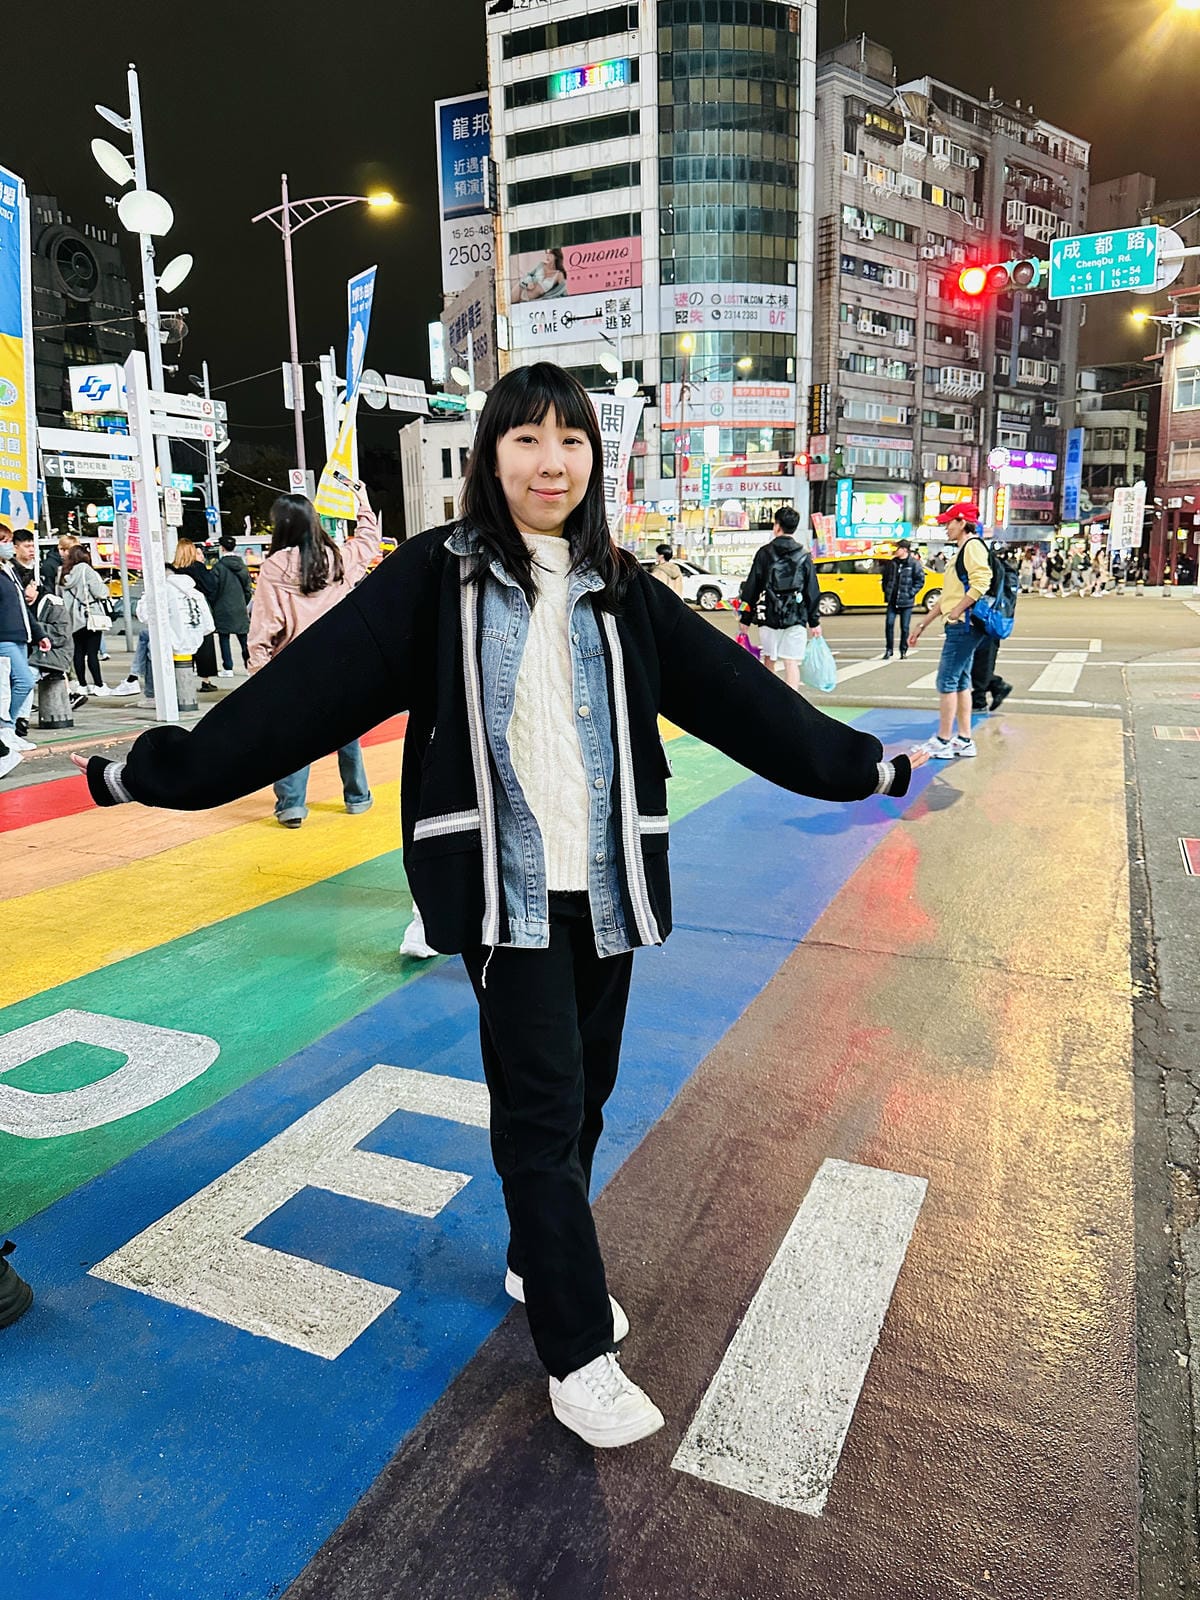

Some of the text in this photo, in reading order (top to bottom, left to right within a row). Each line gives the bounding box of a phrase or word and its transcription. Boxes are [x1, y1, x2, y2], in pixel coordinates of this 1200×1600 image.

[452, 113, 490, 141] 龍邦
[454, 178, 485, 197] 預演
[1062, 231, 1146, 260] 成都路
[568, 247, 629, 269] Qmomo
[1075, 254, 1131, 269] ChengDu Rd.
[531, 322, 558, 335] GAME
